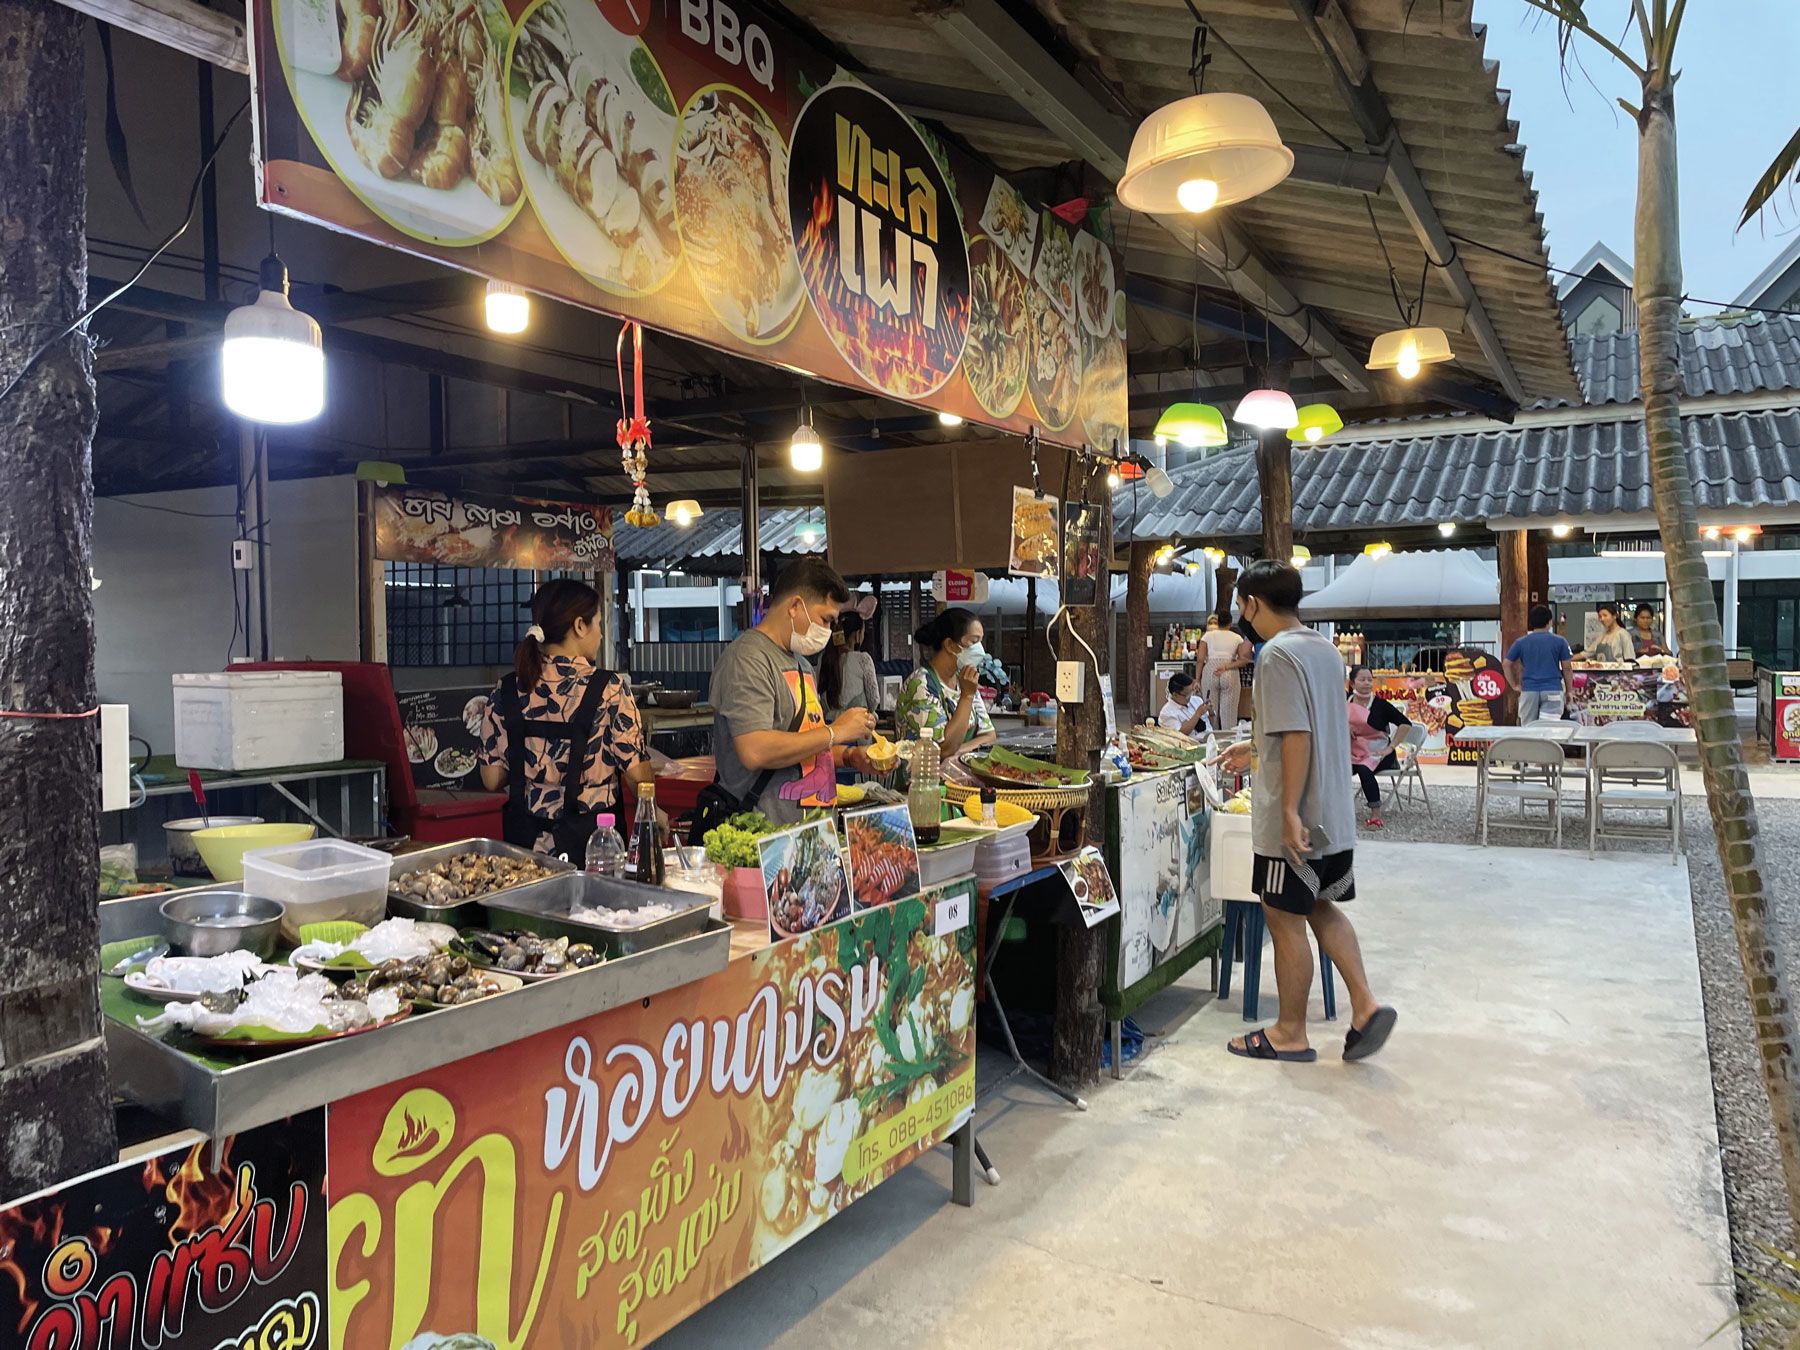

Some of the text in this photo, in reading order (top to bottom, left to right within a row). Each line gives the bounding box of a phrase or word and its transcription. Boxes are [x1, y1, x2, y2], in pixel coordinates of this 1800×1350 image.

[680, 0, 774, 93] BBQ
[835, 112, 938, 243] ทะเล
[948, 904, 958, 920] 08
[543, 956, 881, 1191] หอยนางรม
[889, 1077, 975, 1149] 088-451086
